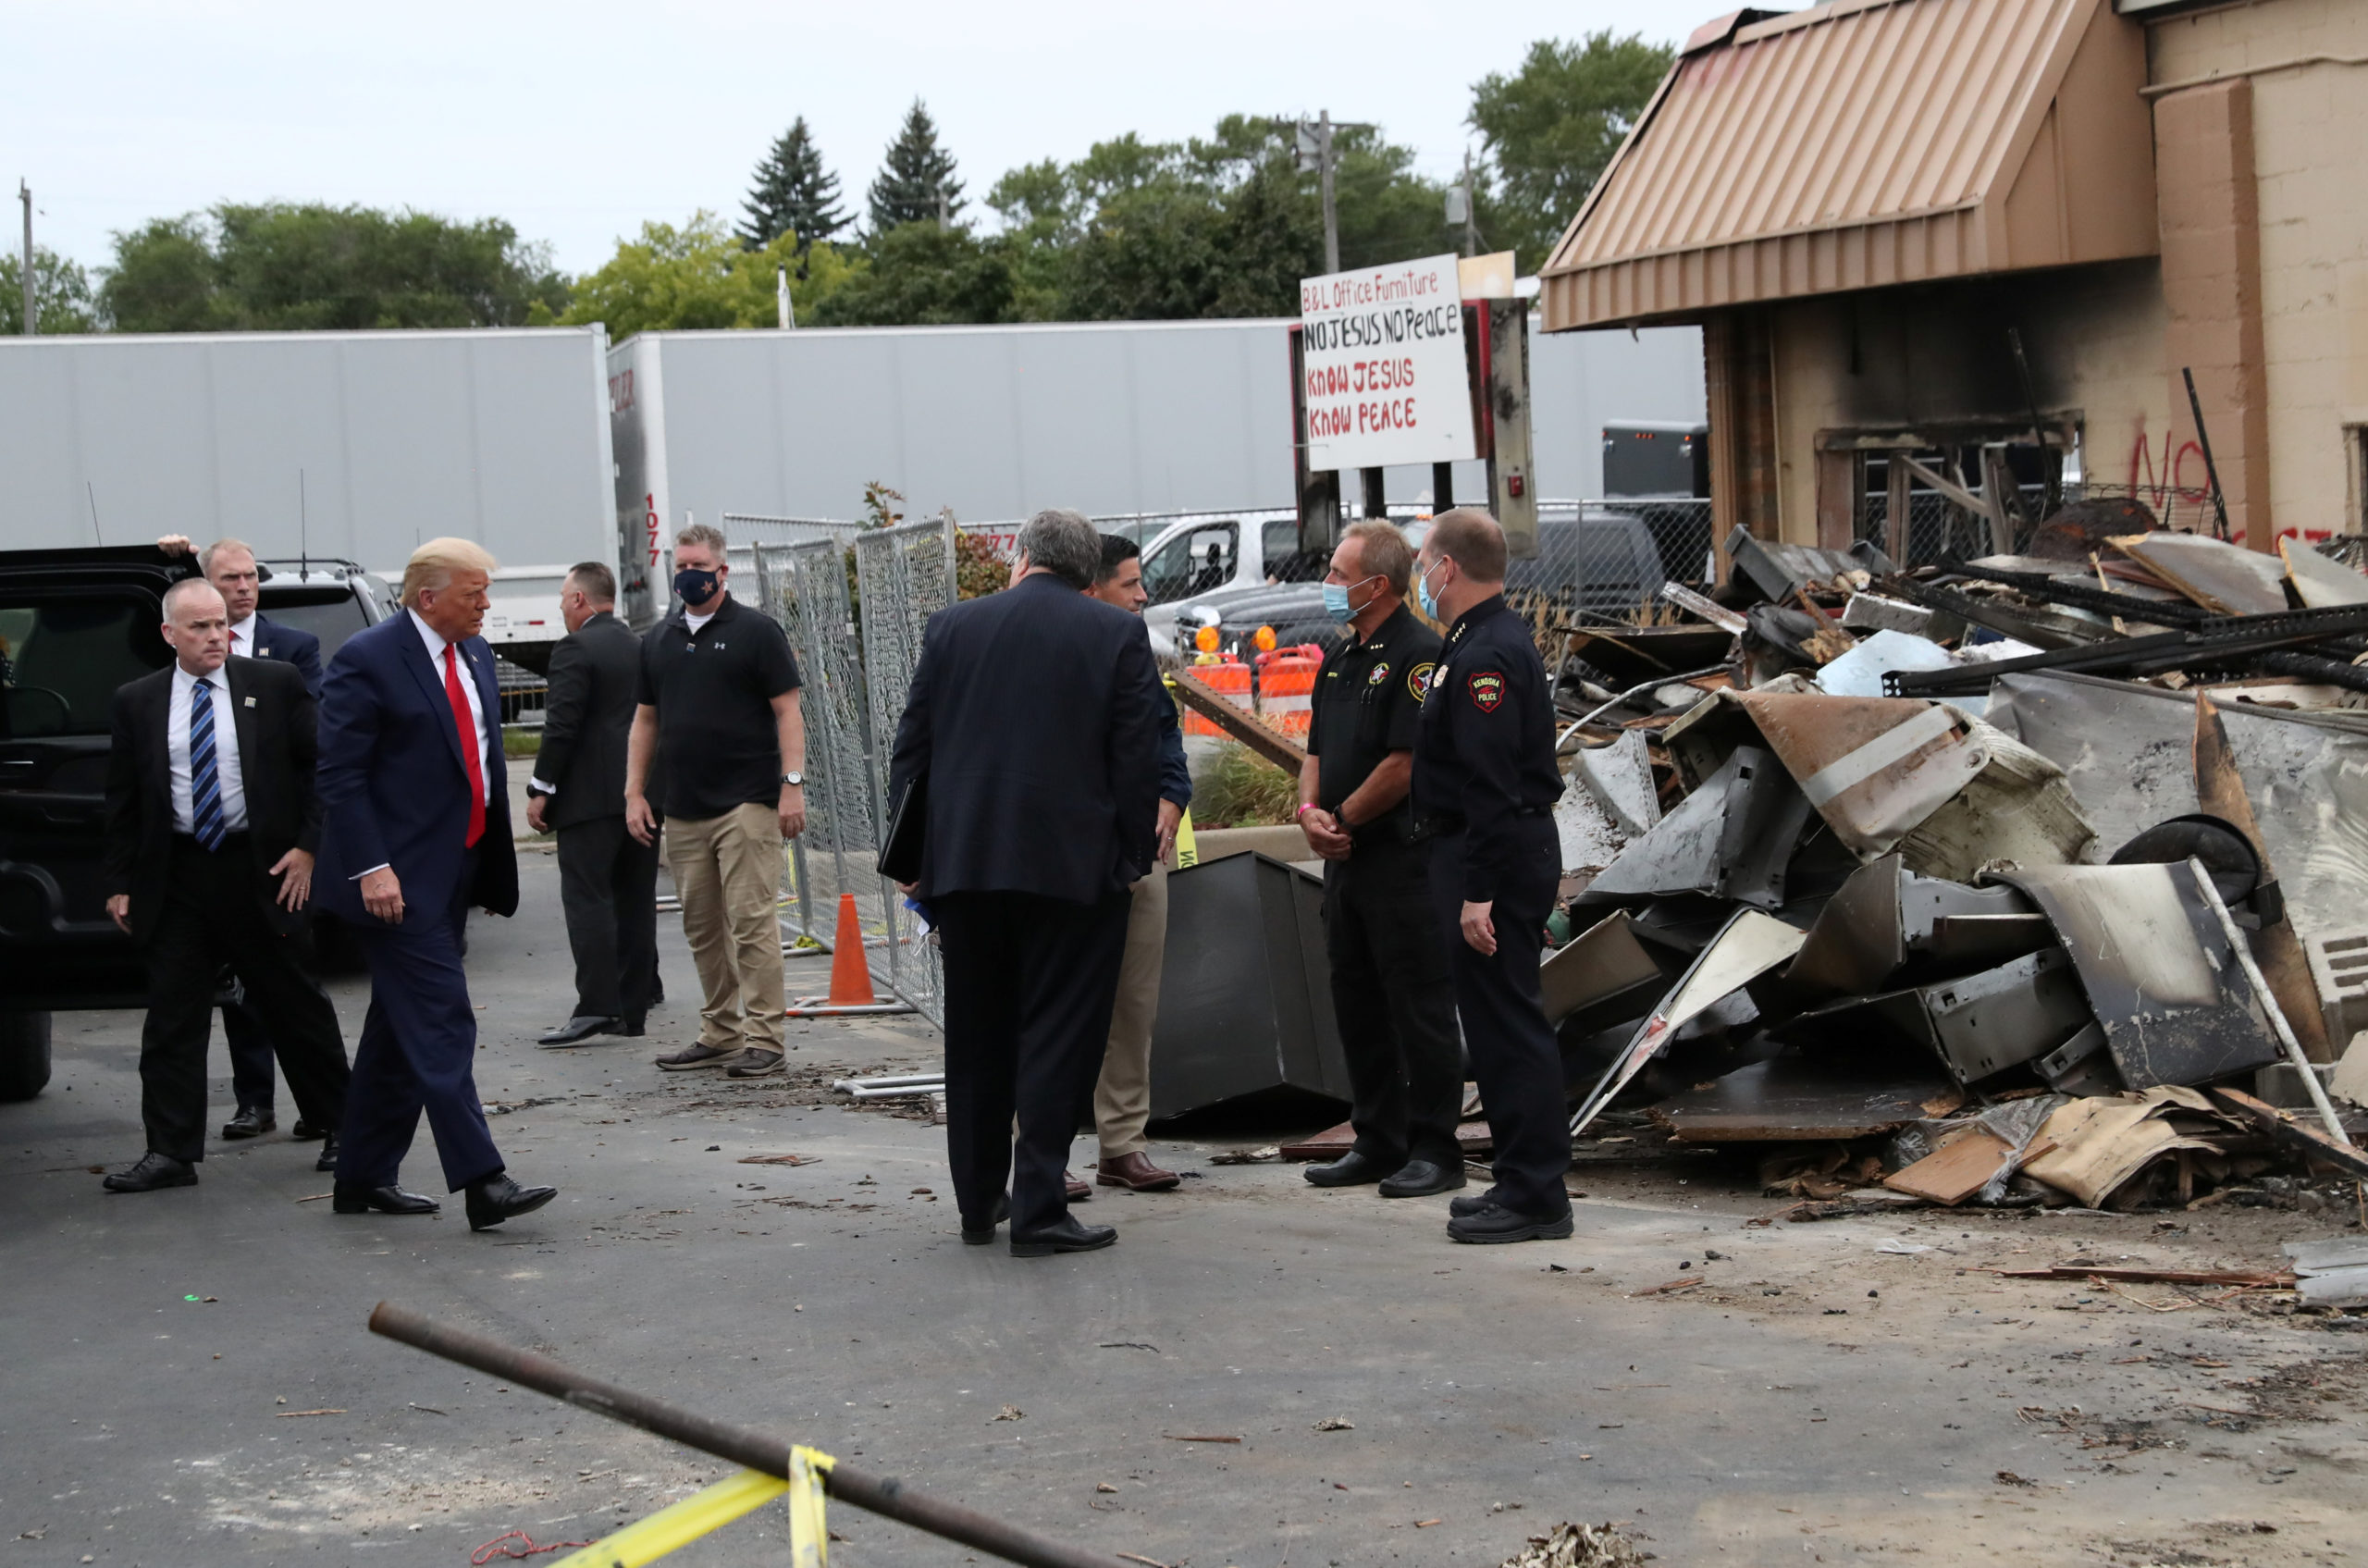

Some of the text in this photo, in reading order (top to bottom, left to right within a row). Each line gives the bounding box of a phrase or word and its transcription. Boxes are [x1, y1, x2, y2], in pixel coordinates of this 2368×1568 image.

[1303, 284, 1330, 313] B&L
[1333, 281, 1373, 309] Office
[1304, 321, 1326, 352] NO
[1329, 312, 1381, 351] JESUS
[1384, 310, 1404, 344] NO
[1353, 357, 1415, 393] JESUS
[1358, 397, 1417, 435] PEACE
[2129, 427, 2212, 509] NO
[646, 492, 660, 567] 1077
[1473, 677, 1500, 689] KENOSHA
[1478, 692, 1498, 702] POLICE
